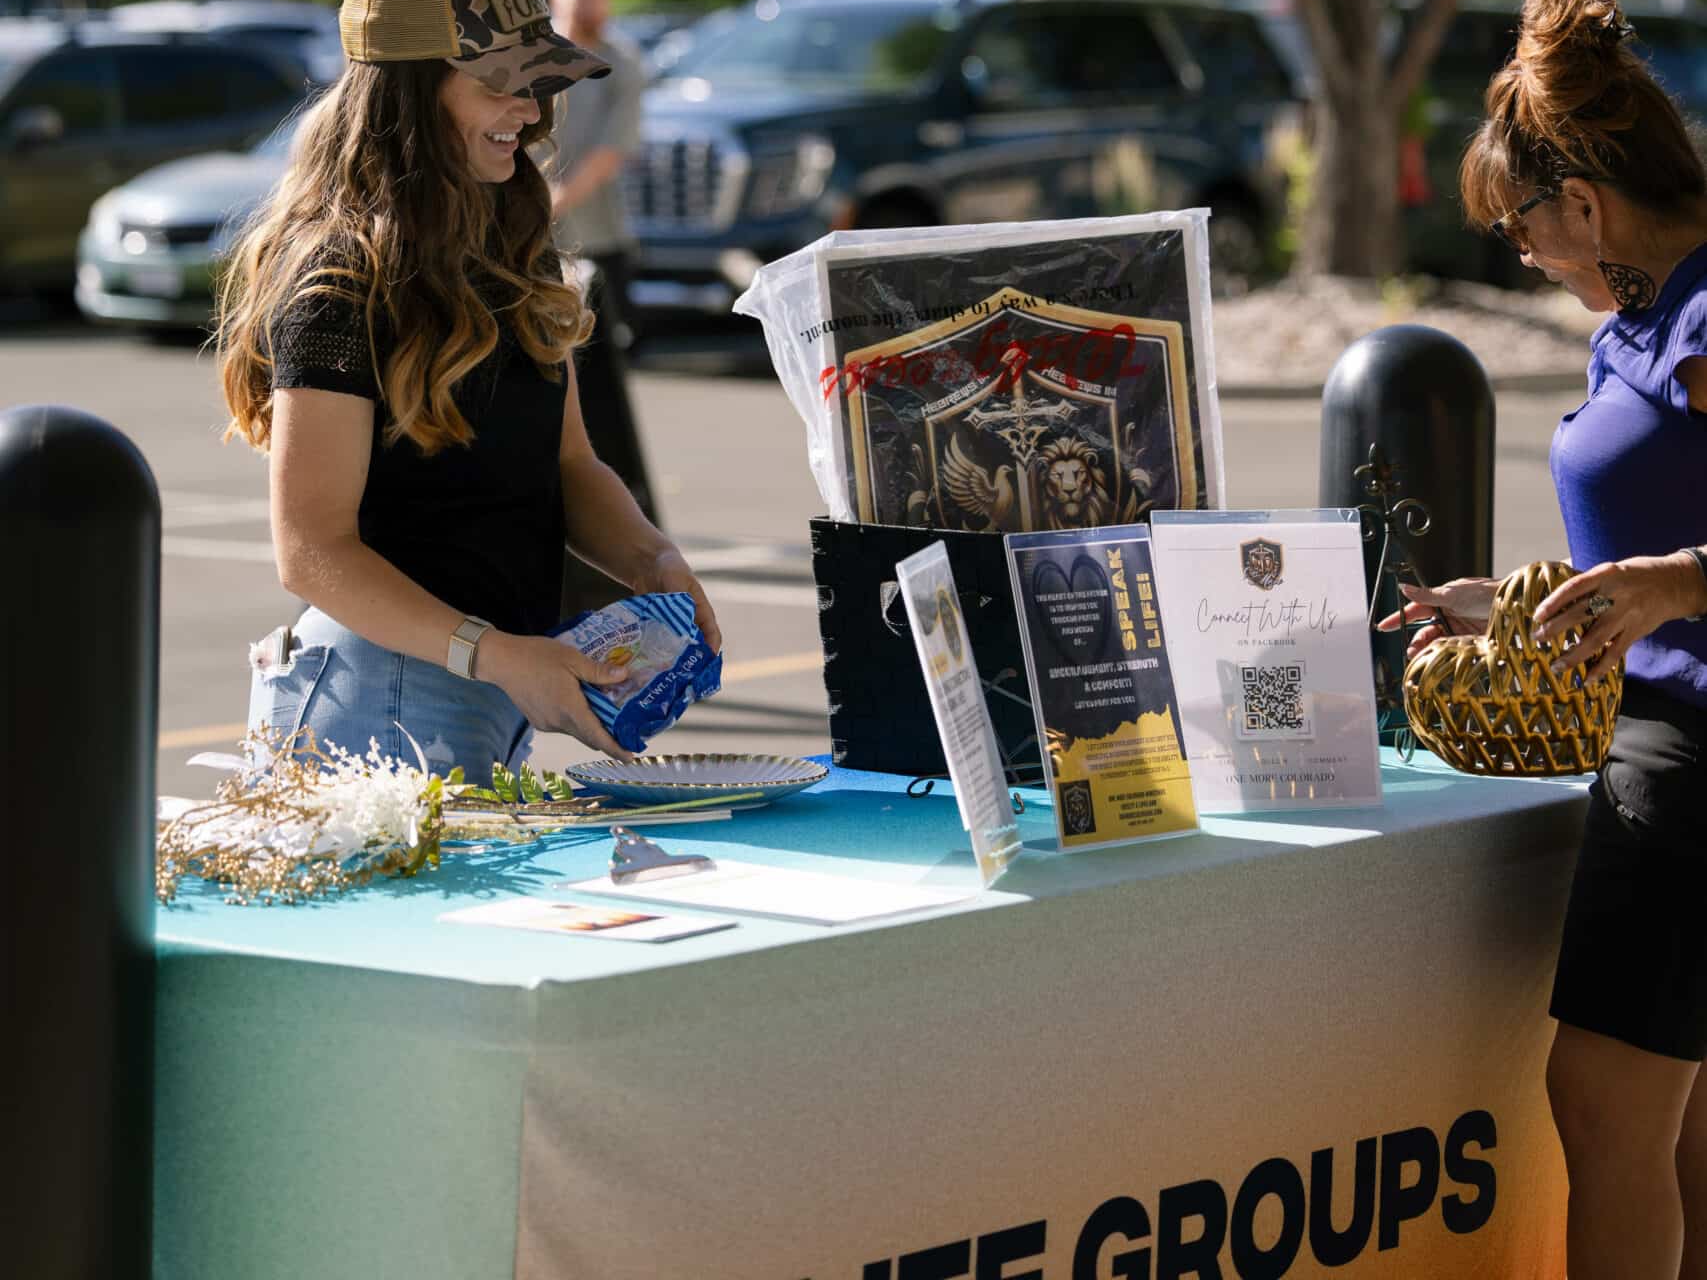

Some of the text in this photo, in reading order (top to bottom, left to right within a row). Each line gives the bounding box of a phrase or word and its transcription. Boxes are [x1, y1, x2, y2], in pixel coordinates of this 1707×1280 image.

[970, 302, 990, 316] to
[999, 293, 1038, 311] way
[871, 312, 903, 329] the
[1106, 548, 1161, 651] SPEAK LIFE!
[1196, 598, 1338, 636] Connect With Us
[665, 672, 677, 683] 12
[1248, 773, 1276, 784] MORE
[1278, 772, 1336, 783] COLORADO
[1071, 1109, 1498, 1280] GROUPS
